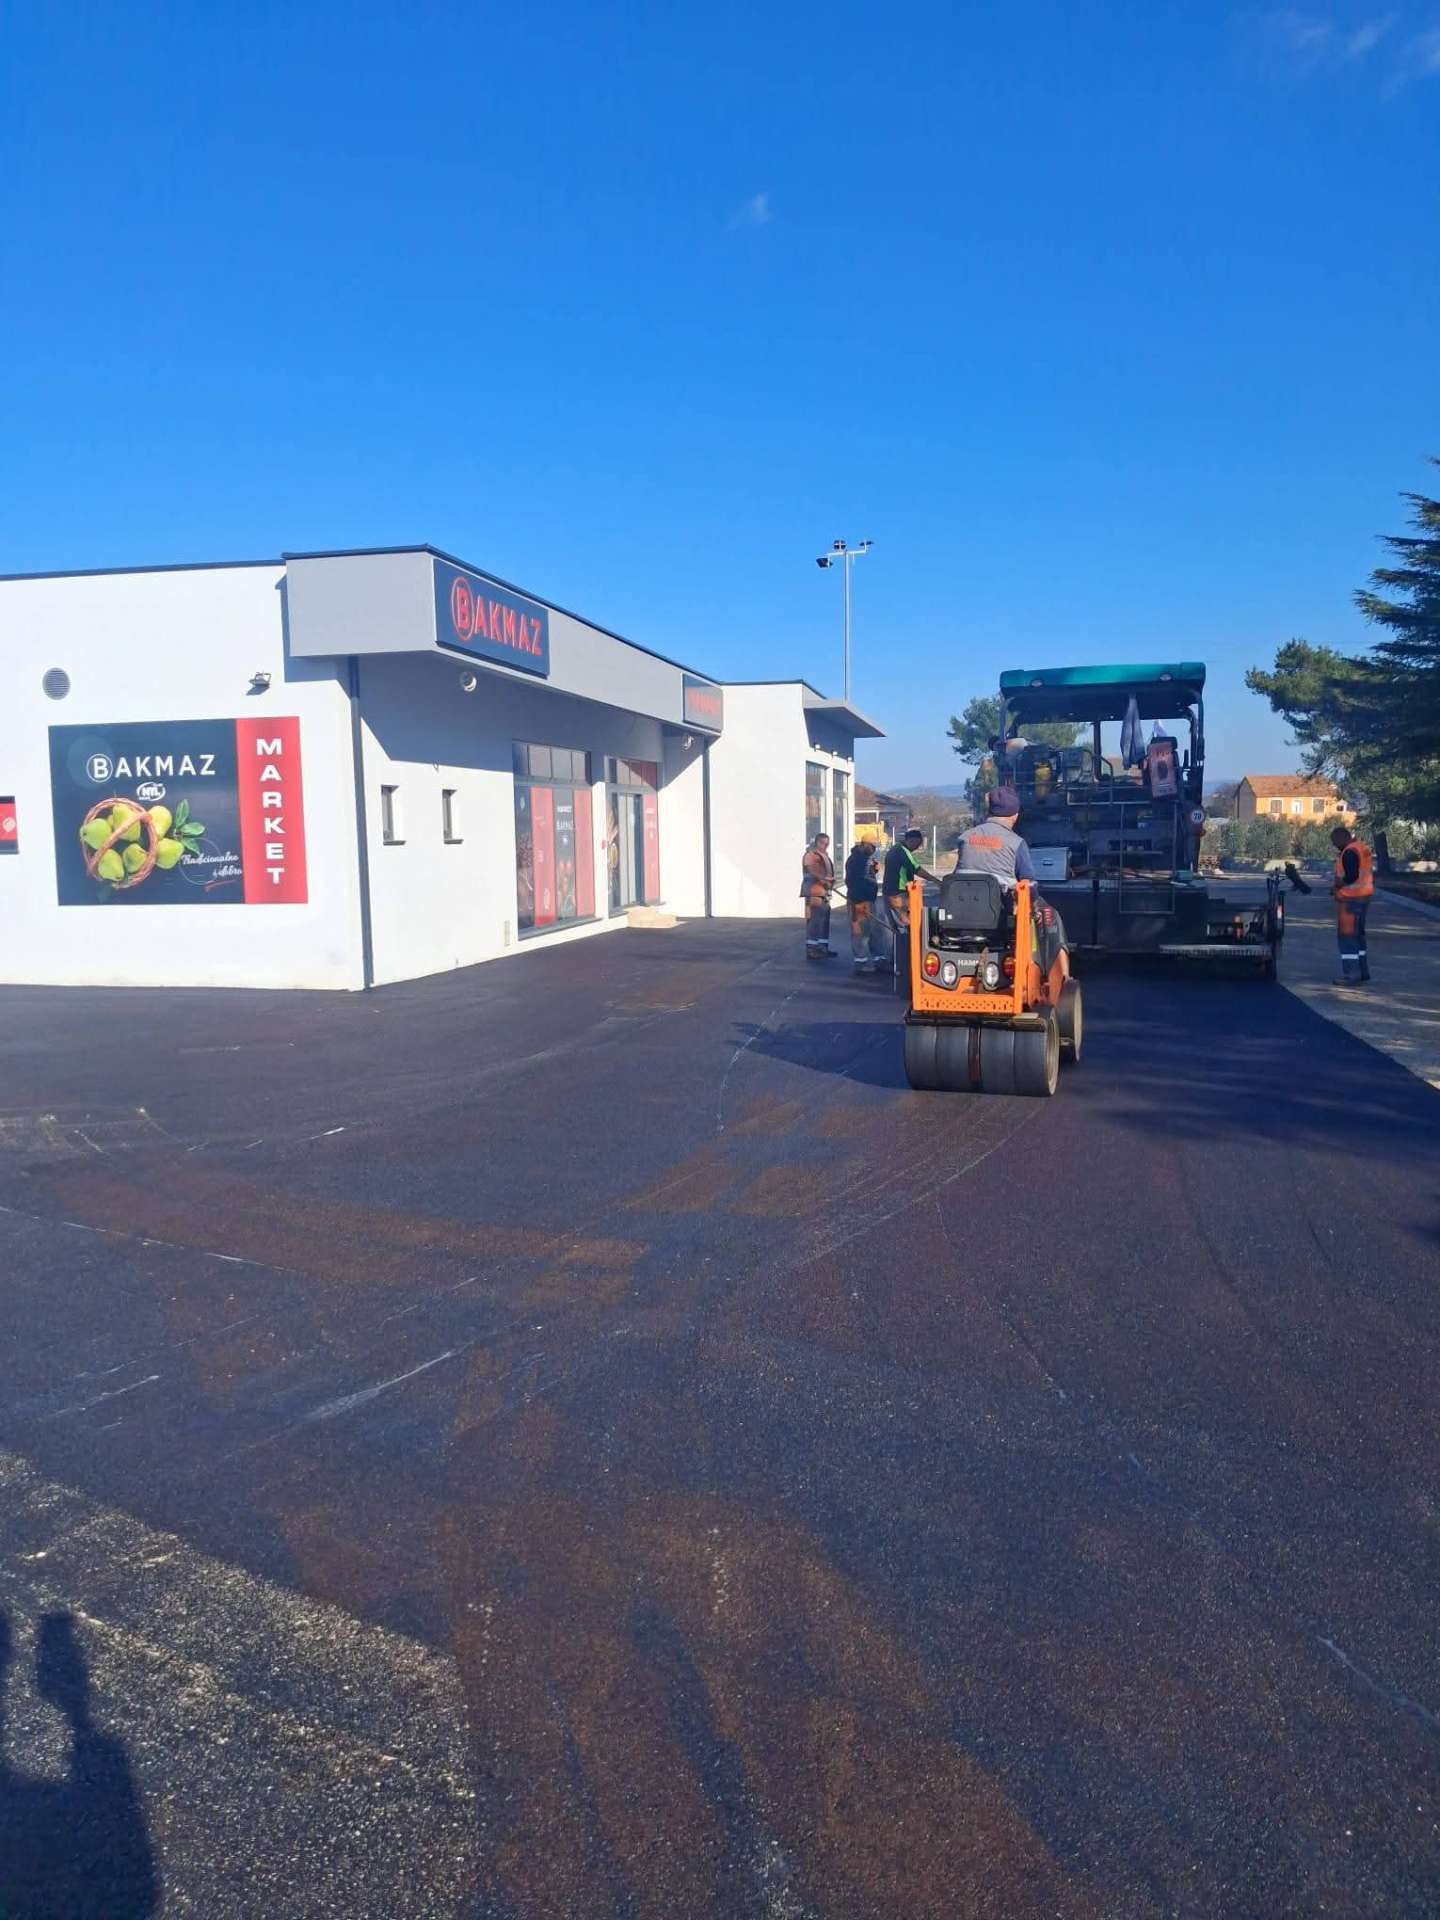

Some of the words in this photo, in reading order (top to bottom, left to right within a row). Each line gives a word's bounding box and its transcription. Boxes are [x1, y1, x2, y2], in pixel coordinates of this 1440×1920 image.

[452, 577, 542, 656] BAKMAZ
[88, 754, 216, 781] BAKMAZ
[256, 738, 285, 884] MARKET
